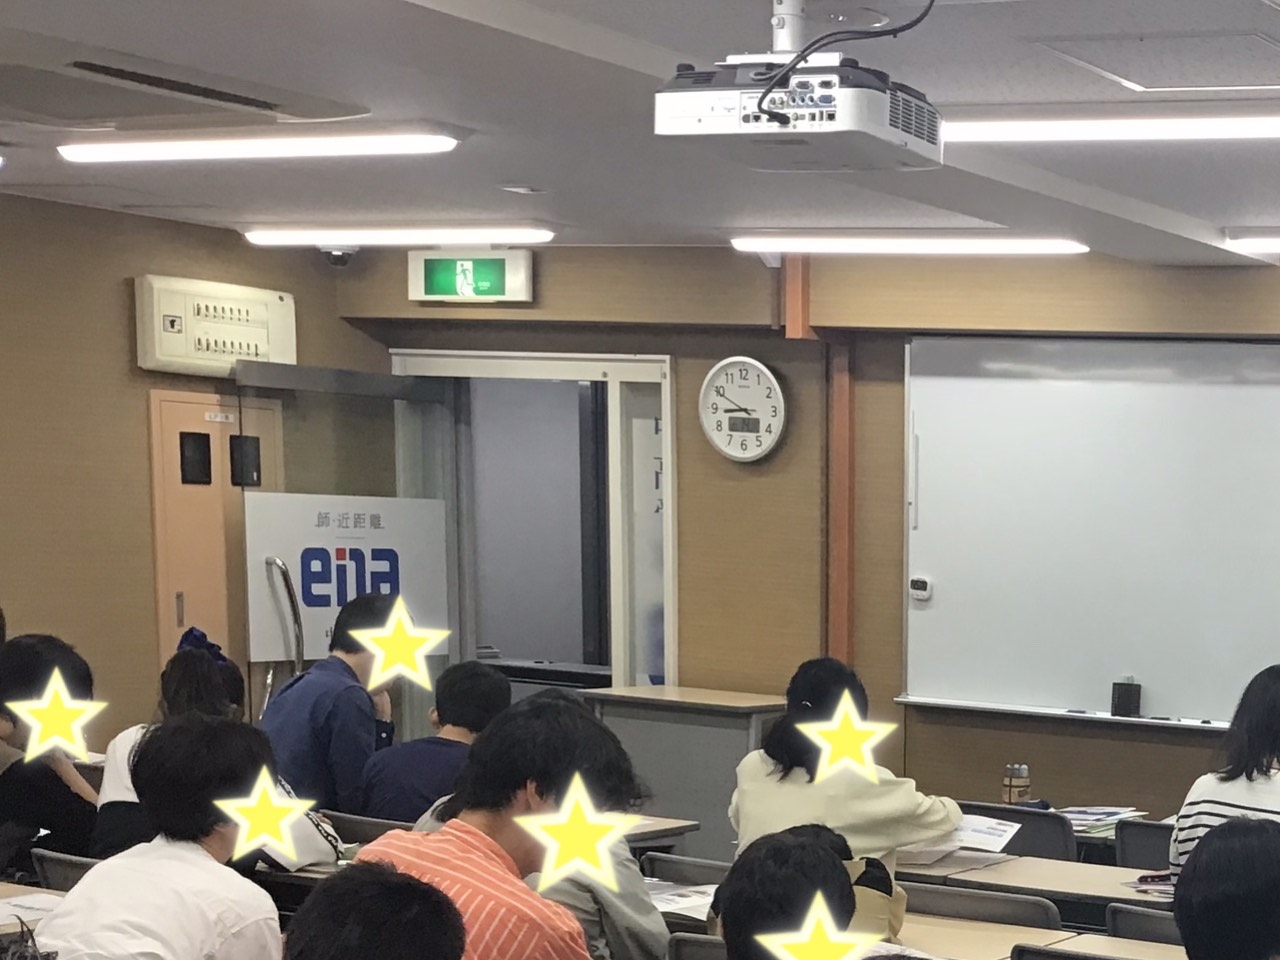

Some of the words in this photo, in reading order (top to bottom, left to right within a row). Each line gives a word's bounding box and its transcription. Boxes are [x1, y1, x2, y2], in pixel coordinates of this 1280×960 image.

[725, 372, 734, 384] 11
[739, 368, 749, 381] 12
[765, 386, 772, 399] 2
[711, 402, 719, 415] 9
[770, 405, 777, 418] 3
[716, 420, 723, 432] 8
[765, 423, 773, 436] 4
[726, 434, 733, 446] 7
[740, 439, 748, 451] 6
[755, 435, 762, 448] 5
